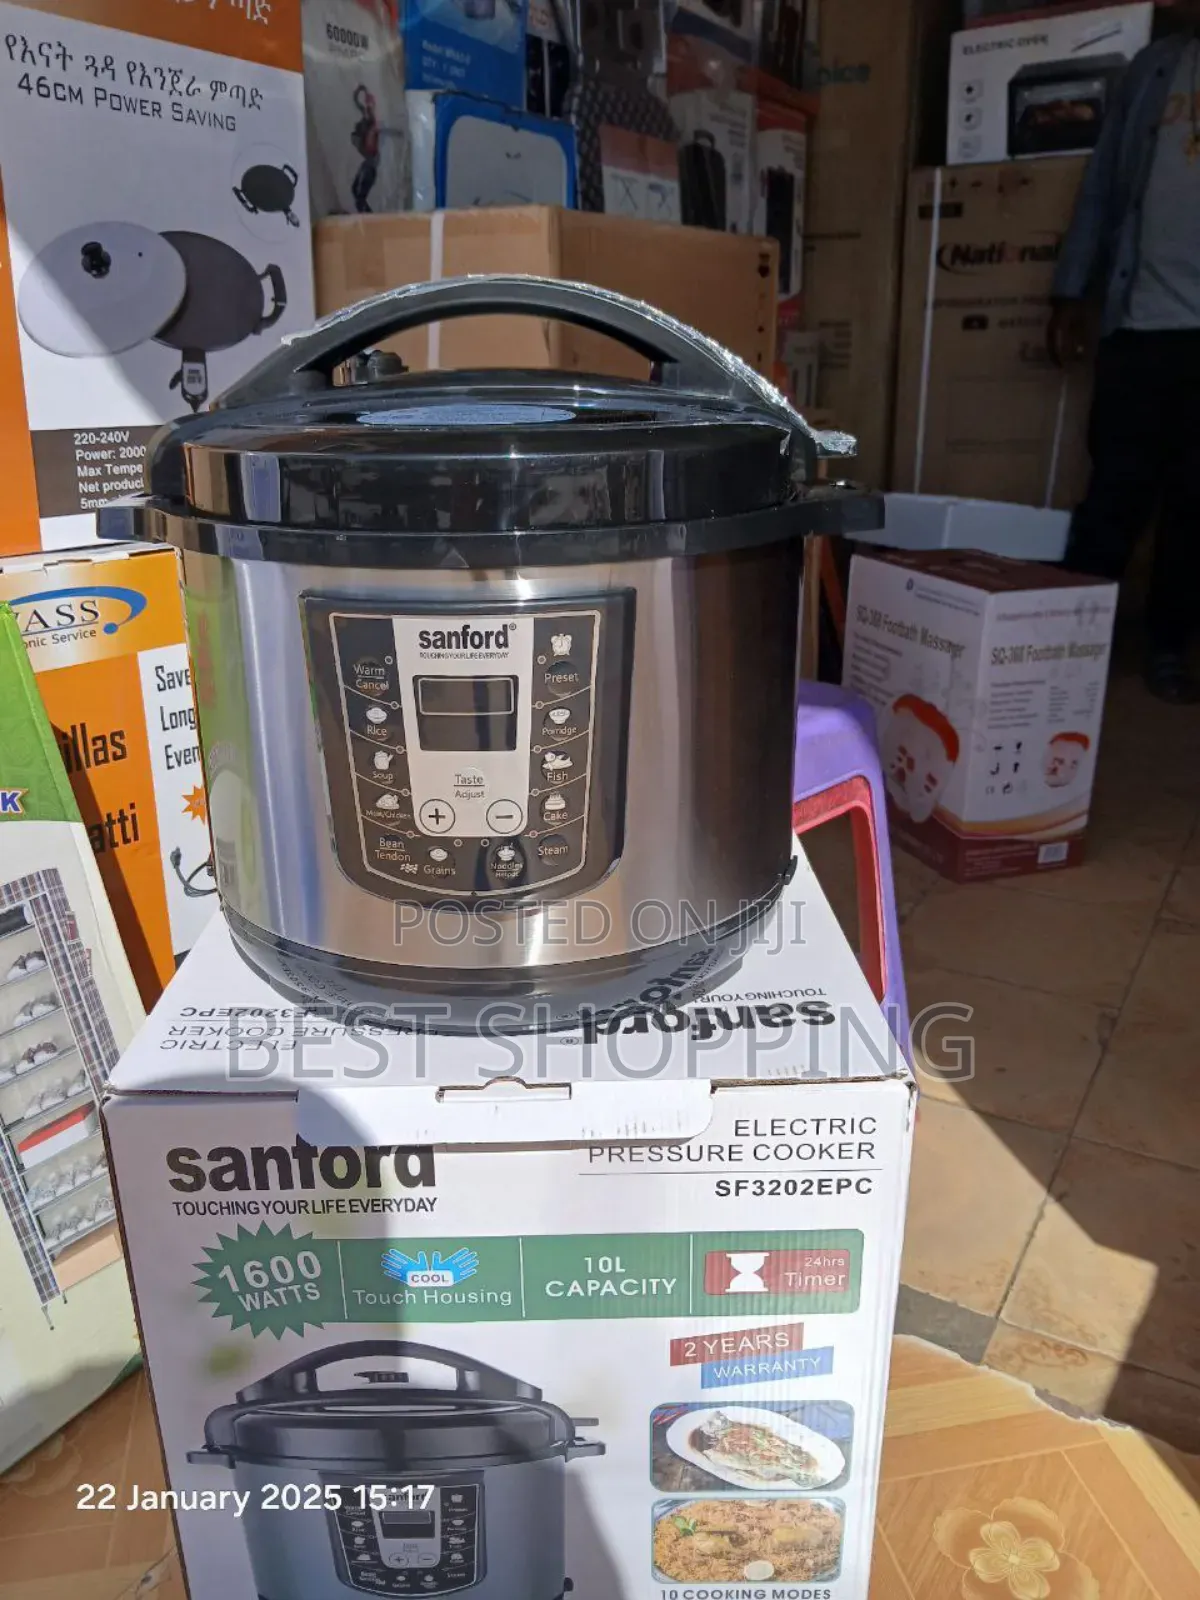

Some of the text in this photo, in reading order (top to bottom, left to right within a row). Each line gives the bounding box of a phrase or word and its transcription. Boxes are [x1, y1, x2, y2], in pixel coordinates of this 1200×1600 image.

[5, 33, 73, 71] የእናት
[18, 73, 83, 105] 46CM
[73, 431, 130, 445] 220-240V
[75, 449, 117, 461] Power:
[77, 465, 101, 478] Max
[79, 482, 100, 493] Net
[13, 600, 100, 632] ASS
[52, 629, 97, 645] Service
[418, 623, 509, 650] sanford
[353, 664, 386, 676] Warm
[543, 672, 580, 684] Preset
[366, 724, 388, 736] Rice
[454, 774, 484, 785] Taste
[546, 771, 569, 782] Fish
[454, 789, 485, 800] Adjust
[543, 811, 569, 821] Cake
[379, 837, 405, 849] Bean
[374, 849, 411, 861] Tendon
[537, 844, 569, 856] Steam
[423, 864, 456, 876] Grains
[745, 987, 827, 1000] TOUCHING
[179, 1007, 318, 1018] F3202EPC
[168, 1023, 438, 1037] ESSURE COOKER
[159, 1039, 298, 1051] ELECTRIC
[733, 1117, 878, 1137] ELECTRIC
[588, 1142, 876, 1164] PRESSURE COOKER
[714, 1177, 873, 1197] SF3202EPC
[173, 1197, 438, 1217] TOUCHING YOUR LIFE EVERYDAY
[583, 1256, 626, 1274] 10L
[803, 1256, 846, 1268] 24hrs
[218, 1250, 323, 1294] 1600
[410, 1273, 450, 1284] COOL
[784, 1272, 847, 1288] Timer
[544, 1278, 677, 1298] CAPACITY
[238, 1282, 321, 1312] WATTS
[351, 1287, 513, 1307] Touch Housing
[683, 1332, 790, 1358] 2 YEARS
[713, 1356, 822, 1380] WARRANTY
[660, 1587, 832, 1600] 10 COOKING MODES
